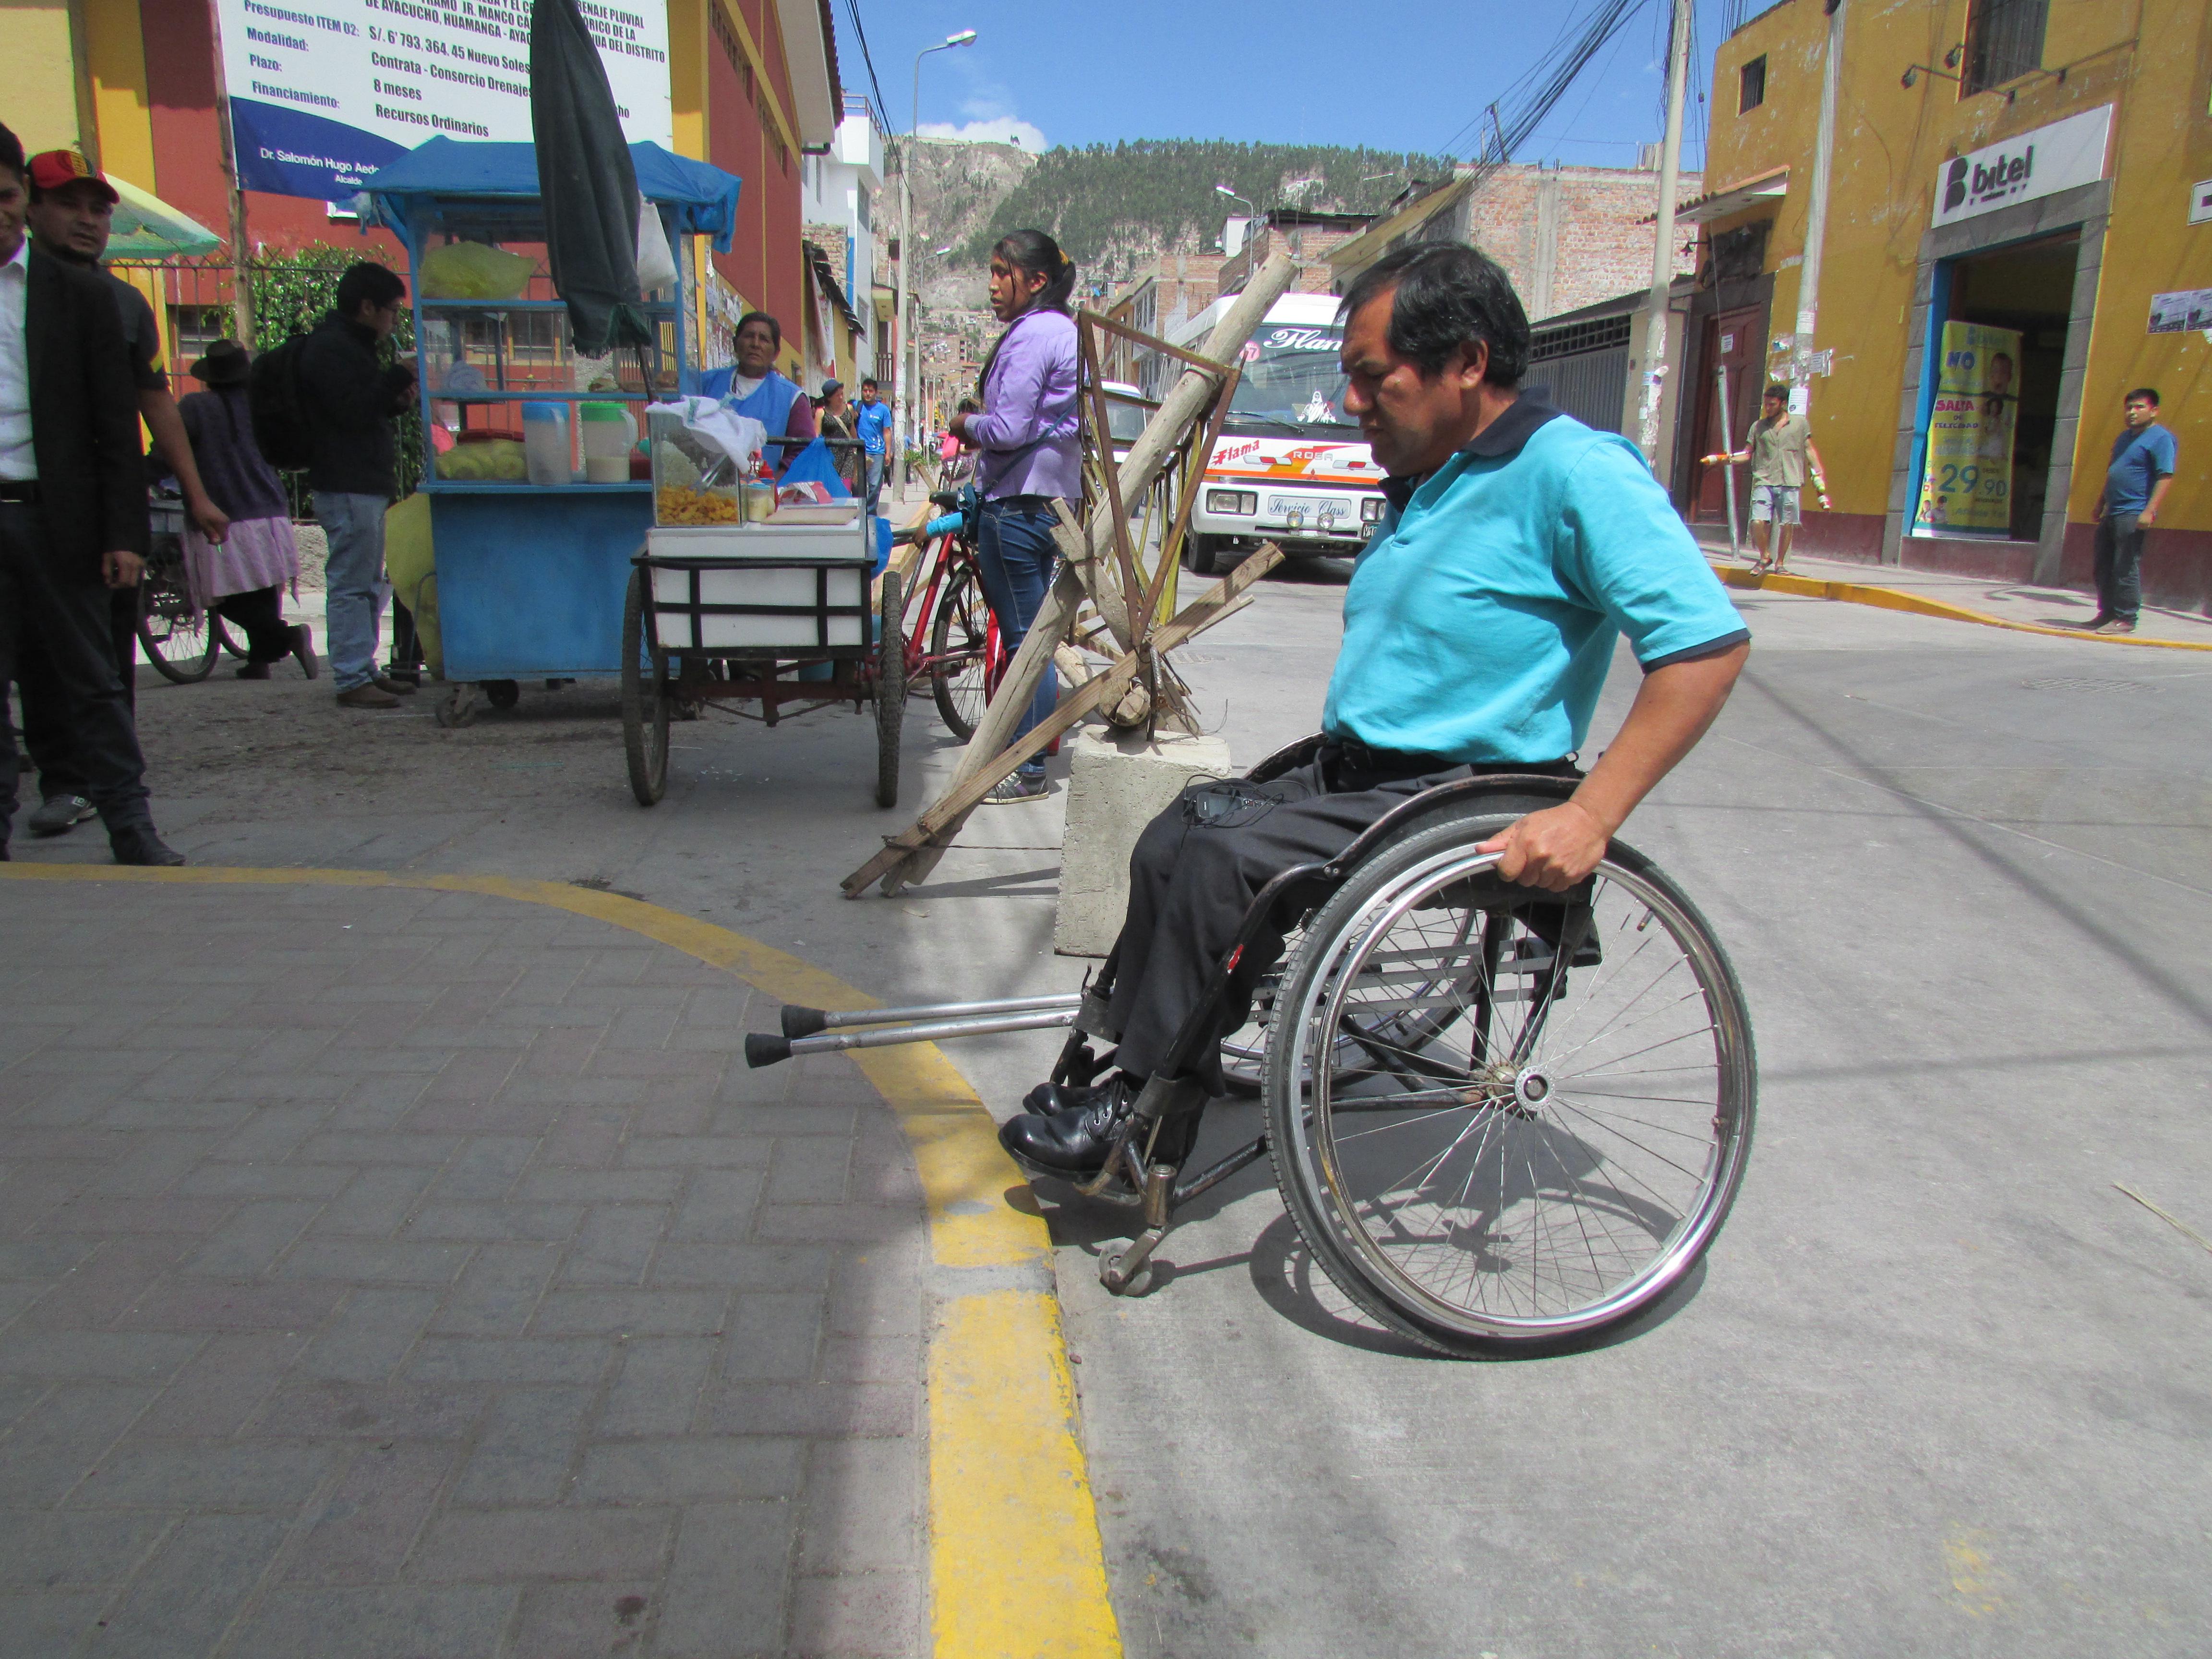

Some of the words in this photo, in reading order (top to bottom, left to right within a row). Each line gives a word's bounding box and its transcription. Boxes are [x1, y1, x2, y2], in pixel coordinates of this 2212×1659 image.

[382, 0, 442, 25] AYACUCHO,
[443, 12, 502, 38] HUAMANGA
[462, 1, 477, 16] JR.
[478, 4, 515, 26] MANCO
[517, 15, 531, 30] CÁ
[510, 0, 521, 12] EL
[577, 1, 608, 20] RENAJE
[609, 8, 645, 29] PLUVIAL
[244, 0, 315, 26] Presupuesto
[316, 15, 342, 34] ITEM
[343, 22, 360, 37] 02:
[369, 25, 386, 42] S/.
[451, 45, 465, 60] 45
[467, 48, 500, 68] Nuevo
[501, 56, 531, 75] Soles
[613, 24, 625, 39] DE
[625, 27, 636, 42] LA
[247, 26, 309, 52] Modalidad:
[371, 51, 422, 75] Contrata
[430, 63, 486, 88] Consorcio
[609, 37, 625, 54] DEL
[625, 42, 665, 63] DISTRITO
[249, 53, 283, 72] Plazo:
[373, 79, 382, 93] 8
[384, 82, 423, 101] meses
[252, 80, 341, 109] Financiamiento:
[375, 103, 430, 126] Recursos
[431, 114, 489, 137] Ordinarios
[260, 147, 276, 160] Dr.
[276, 150, 323, 168] Salomón
[325, 157, 352, 174] Hugo
[1971, 145, 2033, 194] bitel
[335, 174, 363, 186] Alcalde
[1935, 399, 1975, 412] SALTA
[1211, 439, 1260, 466] Flama
[1293, 451, 1334, 461] ROSA
[1937, 463, 1980, 493] 29
[1270, 498, 1311, 514] Servicio
[1318, 500, 1347, 516] Class
